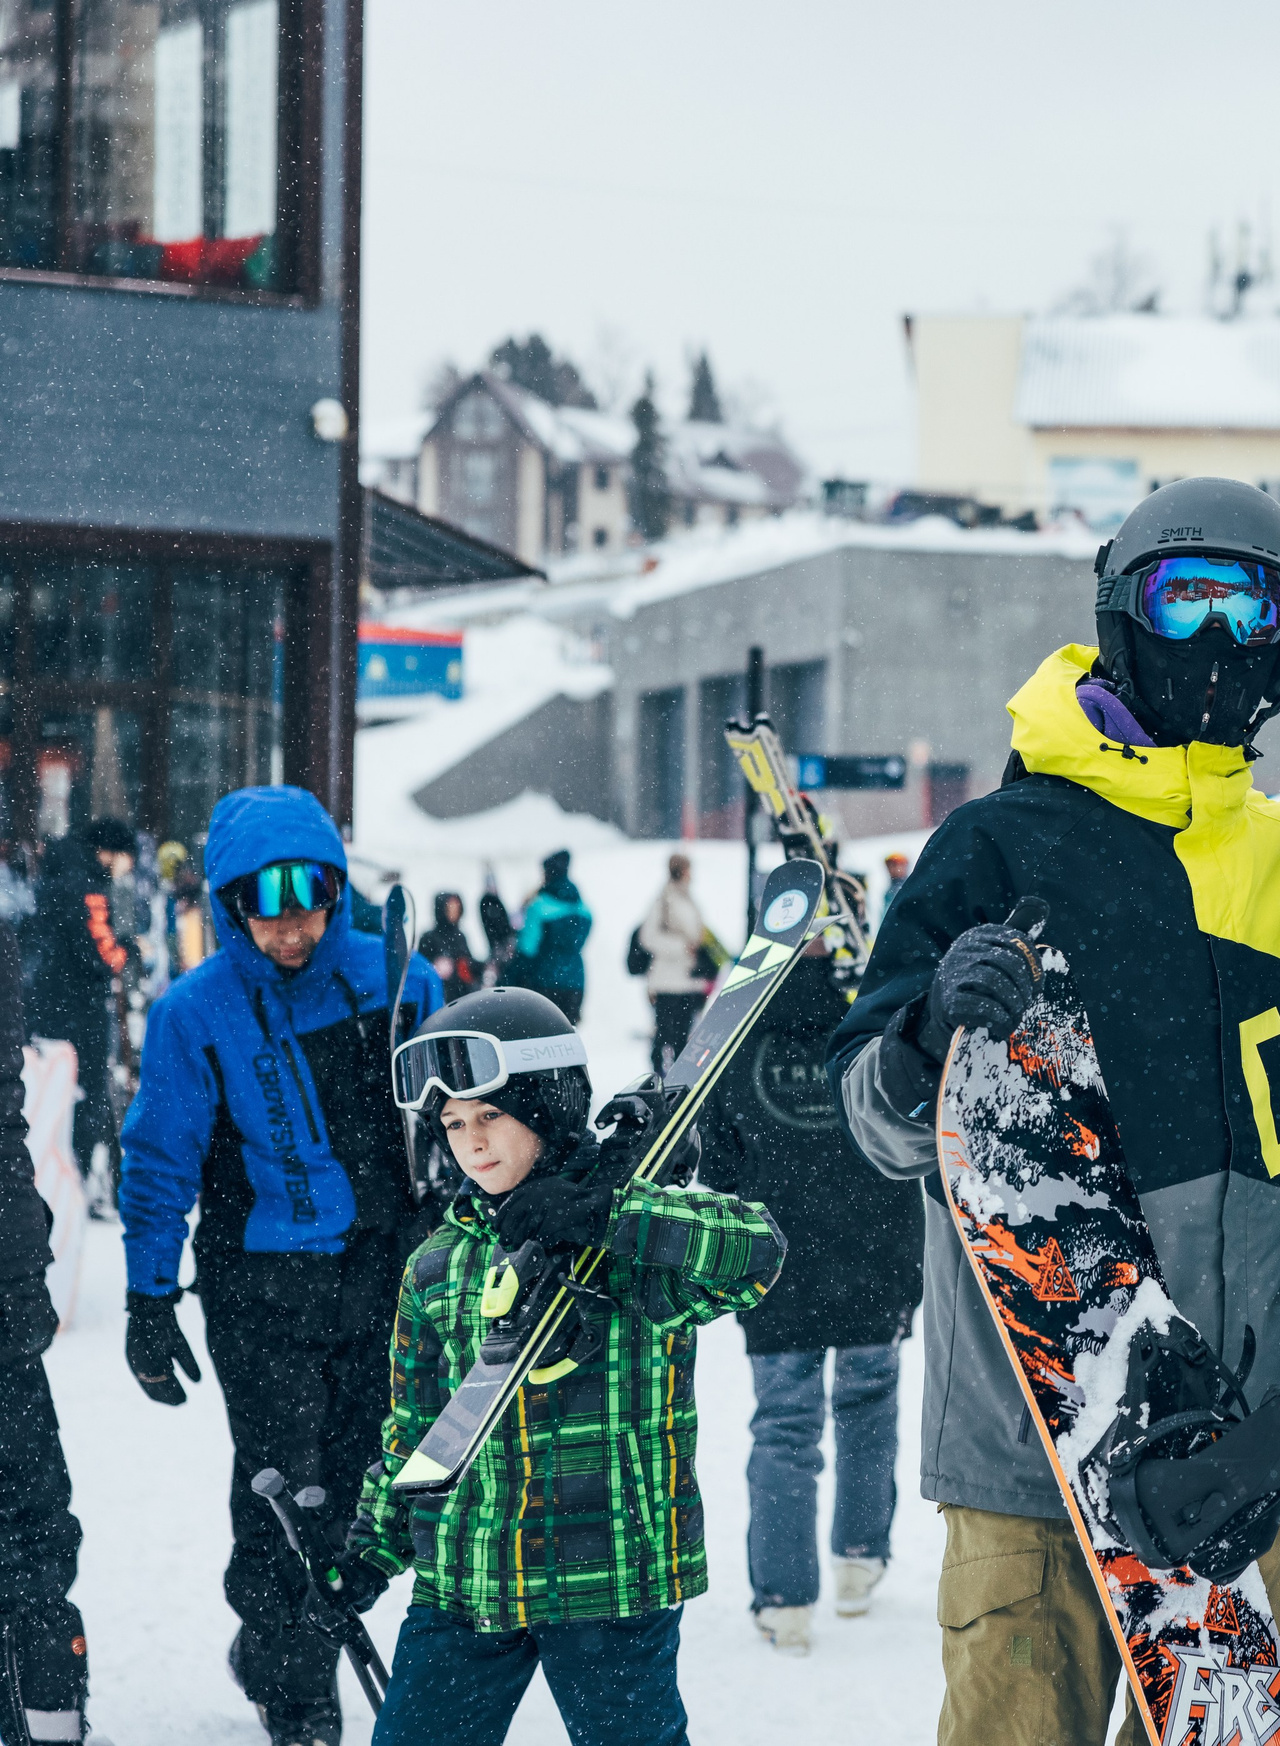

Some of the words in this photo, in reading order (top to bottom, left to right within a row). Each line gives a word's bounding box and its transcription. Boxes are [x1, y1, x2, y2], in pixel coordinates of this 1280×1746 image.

[1161, 527, 1202, 538] SMITH
[1009, 938, 1042, 982] reusch
[520, 1044, 575, 1061] SMITH
